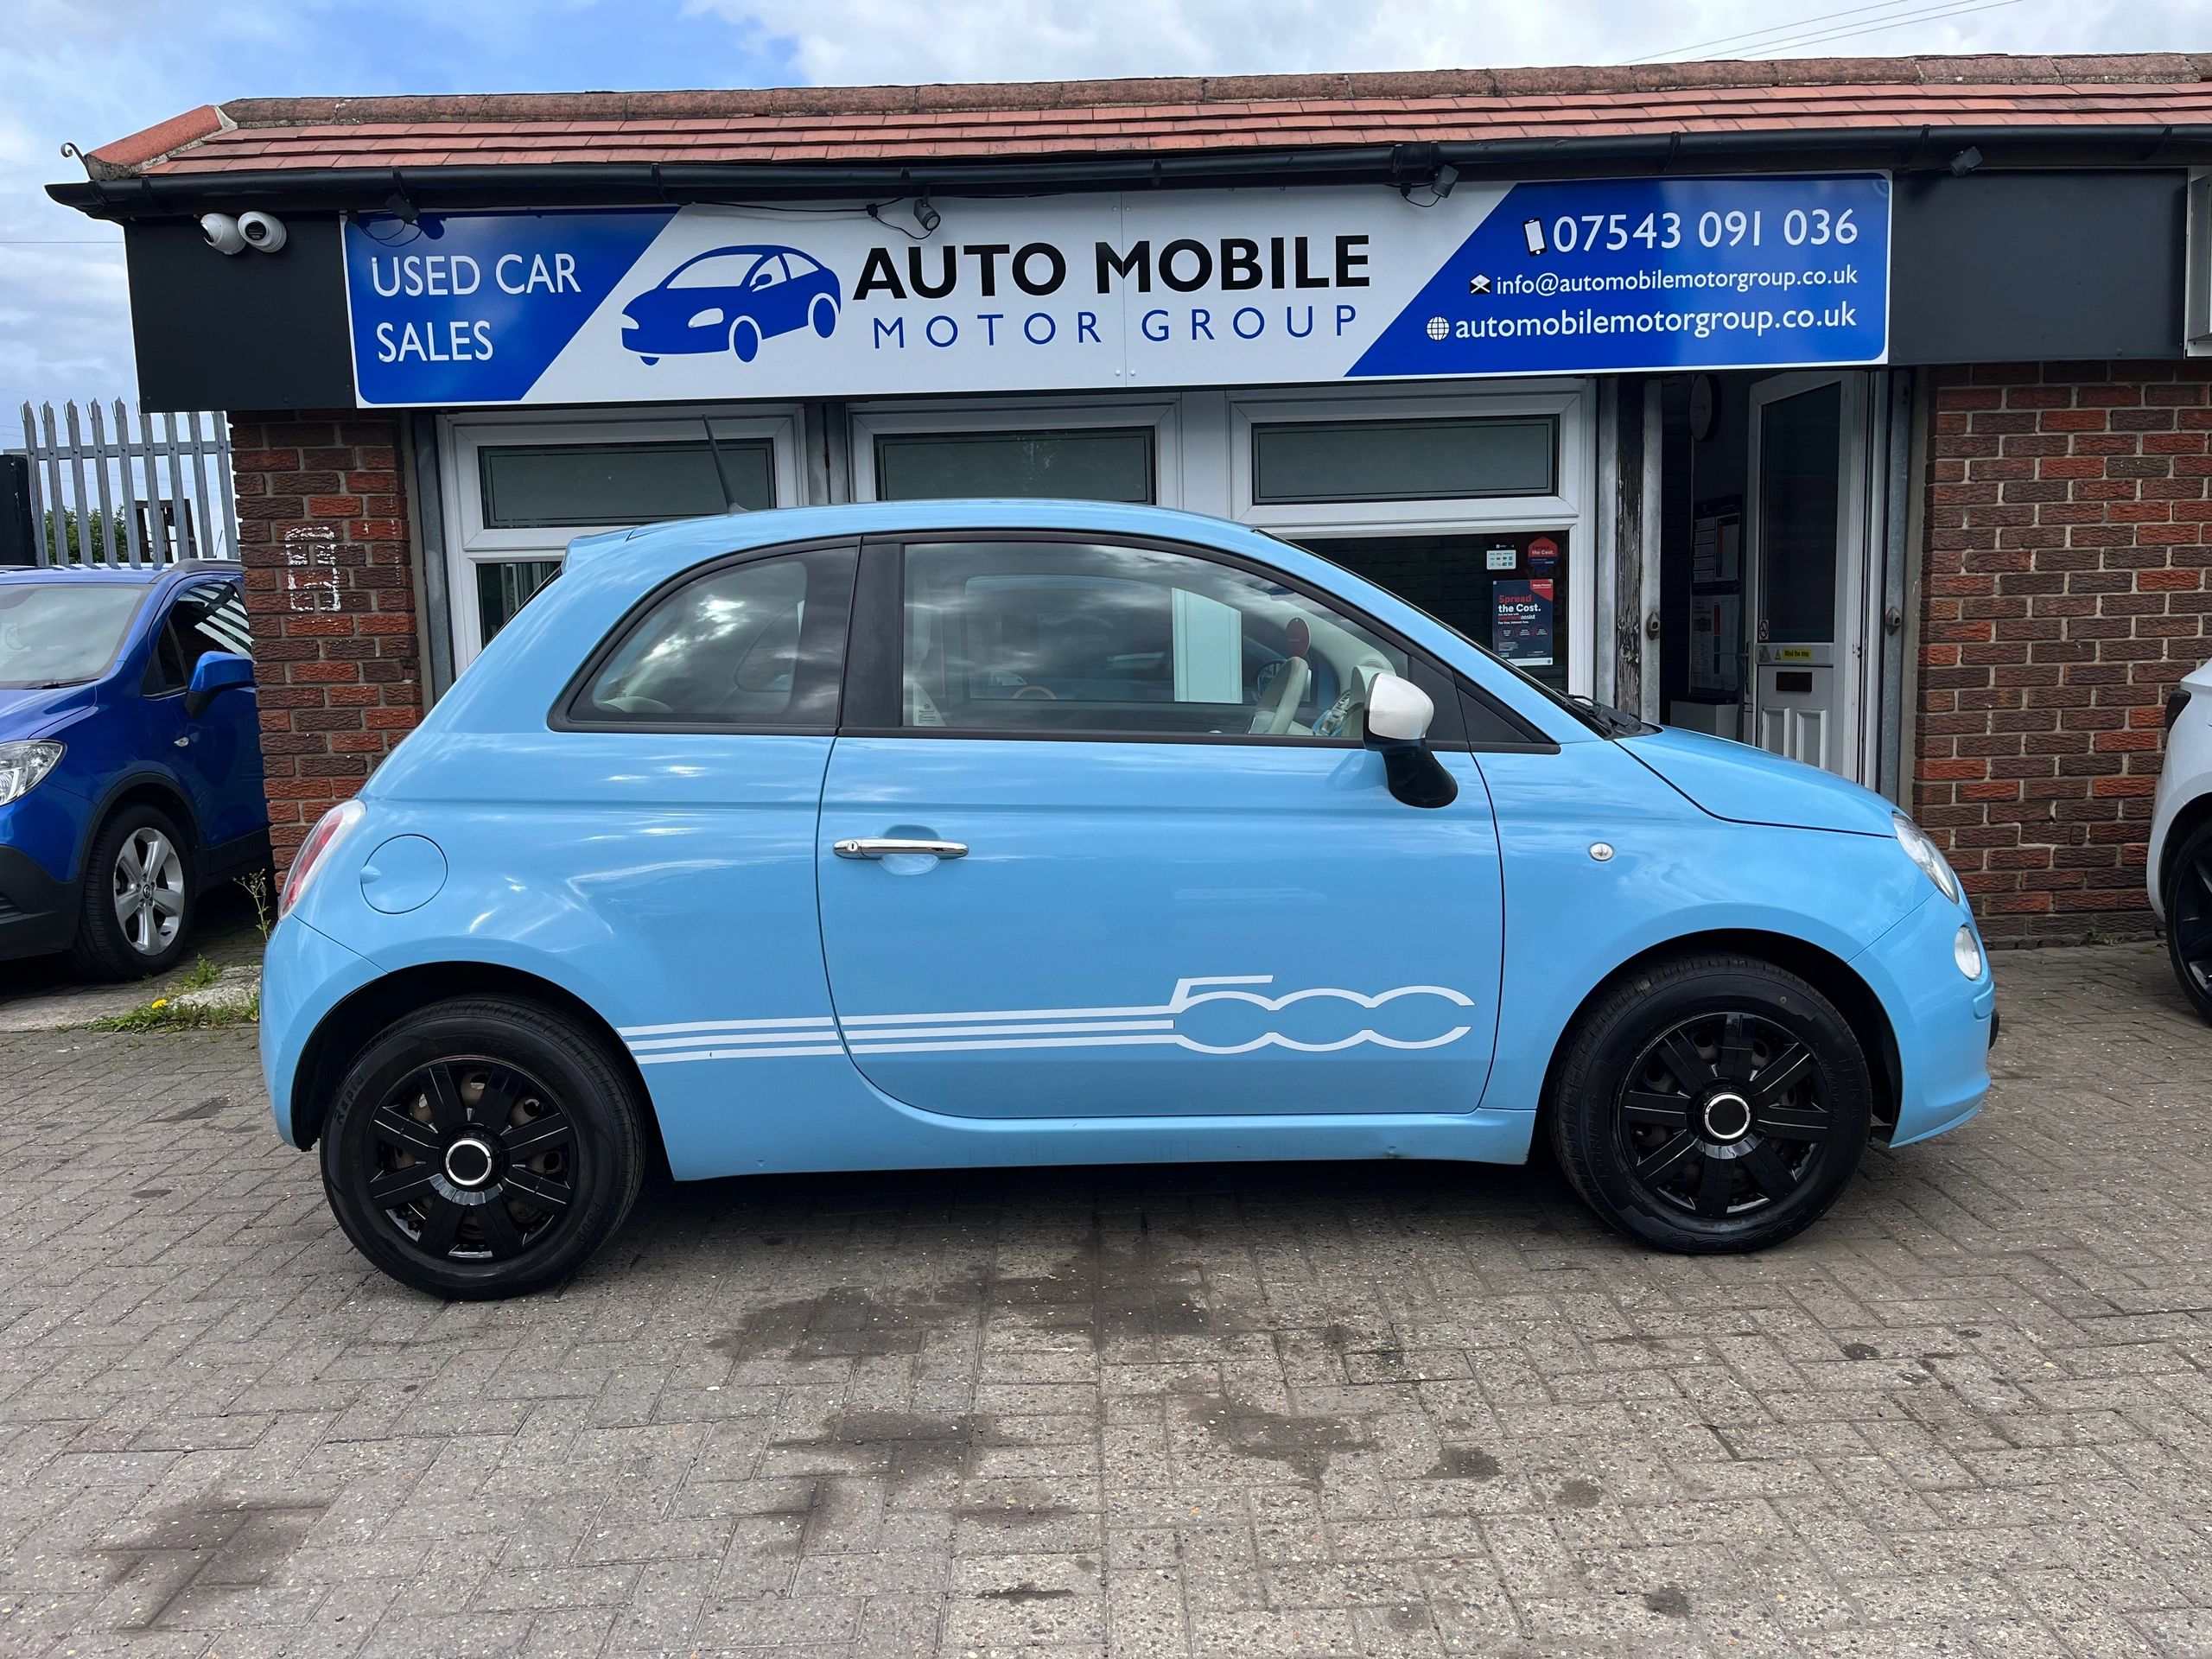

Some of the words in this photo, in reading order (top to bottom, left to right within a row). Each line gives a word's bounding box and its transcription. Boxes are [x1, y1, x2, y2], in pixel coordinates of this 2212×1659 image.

[1553, 212, 1681, 252] 07543
[1698, 209, 1762, 248] 091
[1783, 207, 1859, 246] 036
[371, 255, 480, 297] USED
[495, 252, 582, 295] CAR
[852, 242, 1066, 300] AUTO
[1096, 234, 1370, 295] MOBILE
[1496, 264, 1858, 296] info@automobilemotorgroup.co.uk
[376, 320, 493, 363] SALES
[872, 309, 1101, 350] MOTOR
[1141, 303, 1357, 343] GROUP
[1455, 301, 1857, 339] automobilemotorgroup.co.uk
[1498, 594, 1532, 604] Spread
[1516, 603, 1541, 612] Cost.
[1169, 975, 1476, 1054] 500
